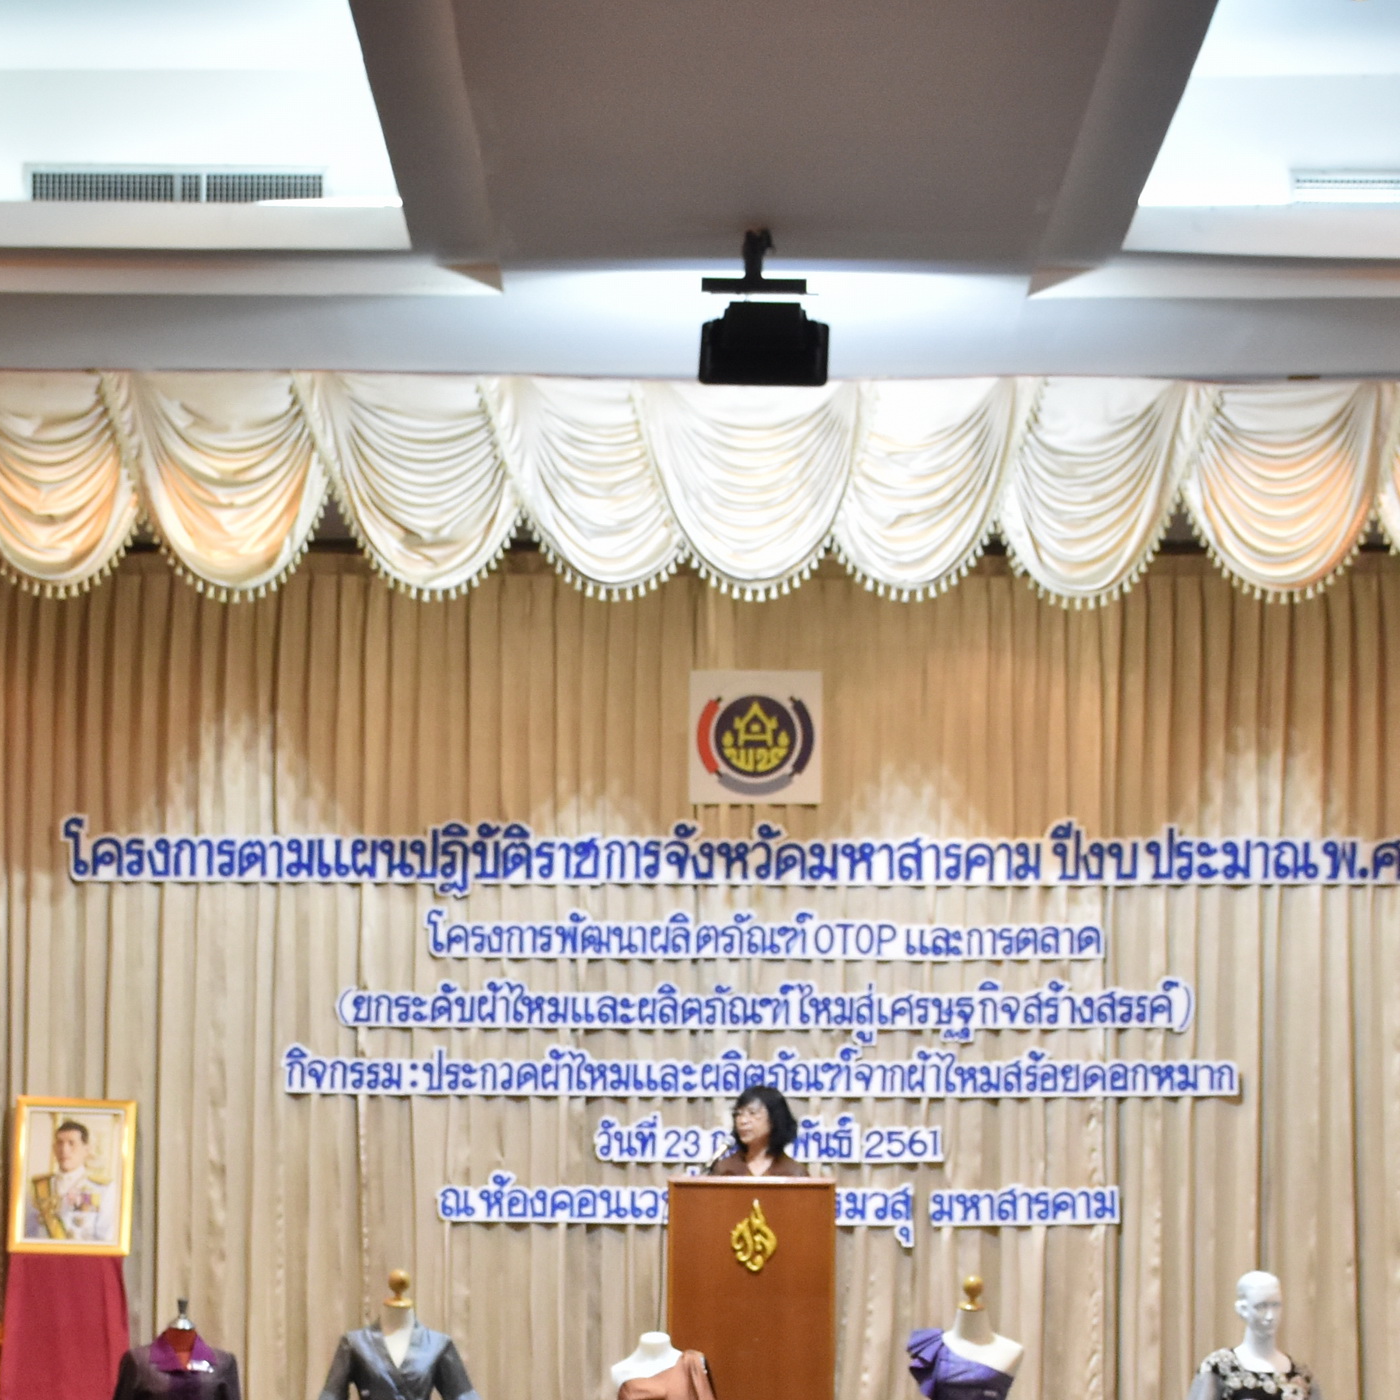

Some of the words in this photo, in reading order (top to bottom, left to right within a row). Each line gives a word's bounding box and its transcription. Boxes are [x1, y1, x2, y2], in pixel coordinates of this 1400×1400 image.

[812, 922, 898, 957] OTOP
[663, 1128, 702, 1159] 23
[864, 1129, 941, 1159] 2561
